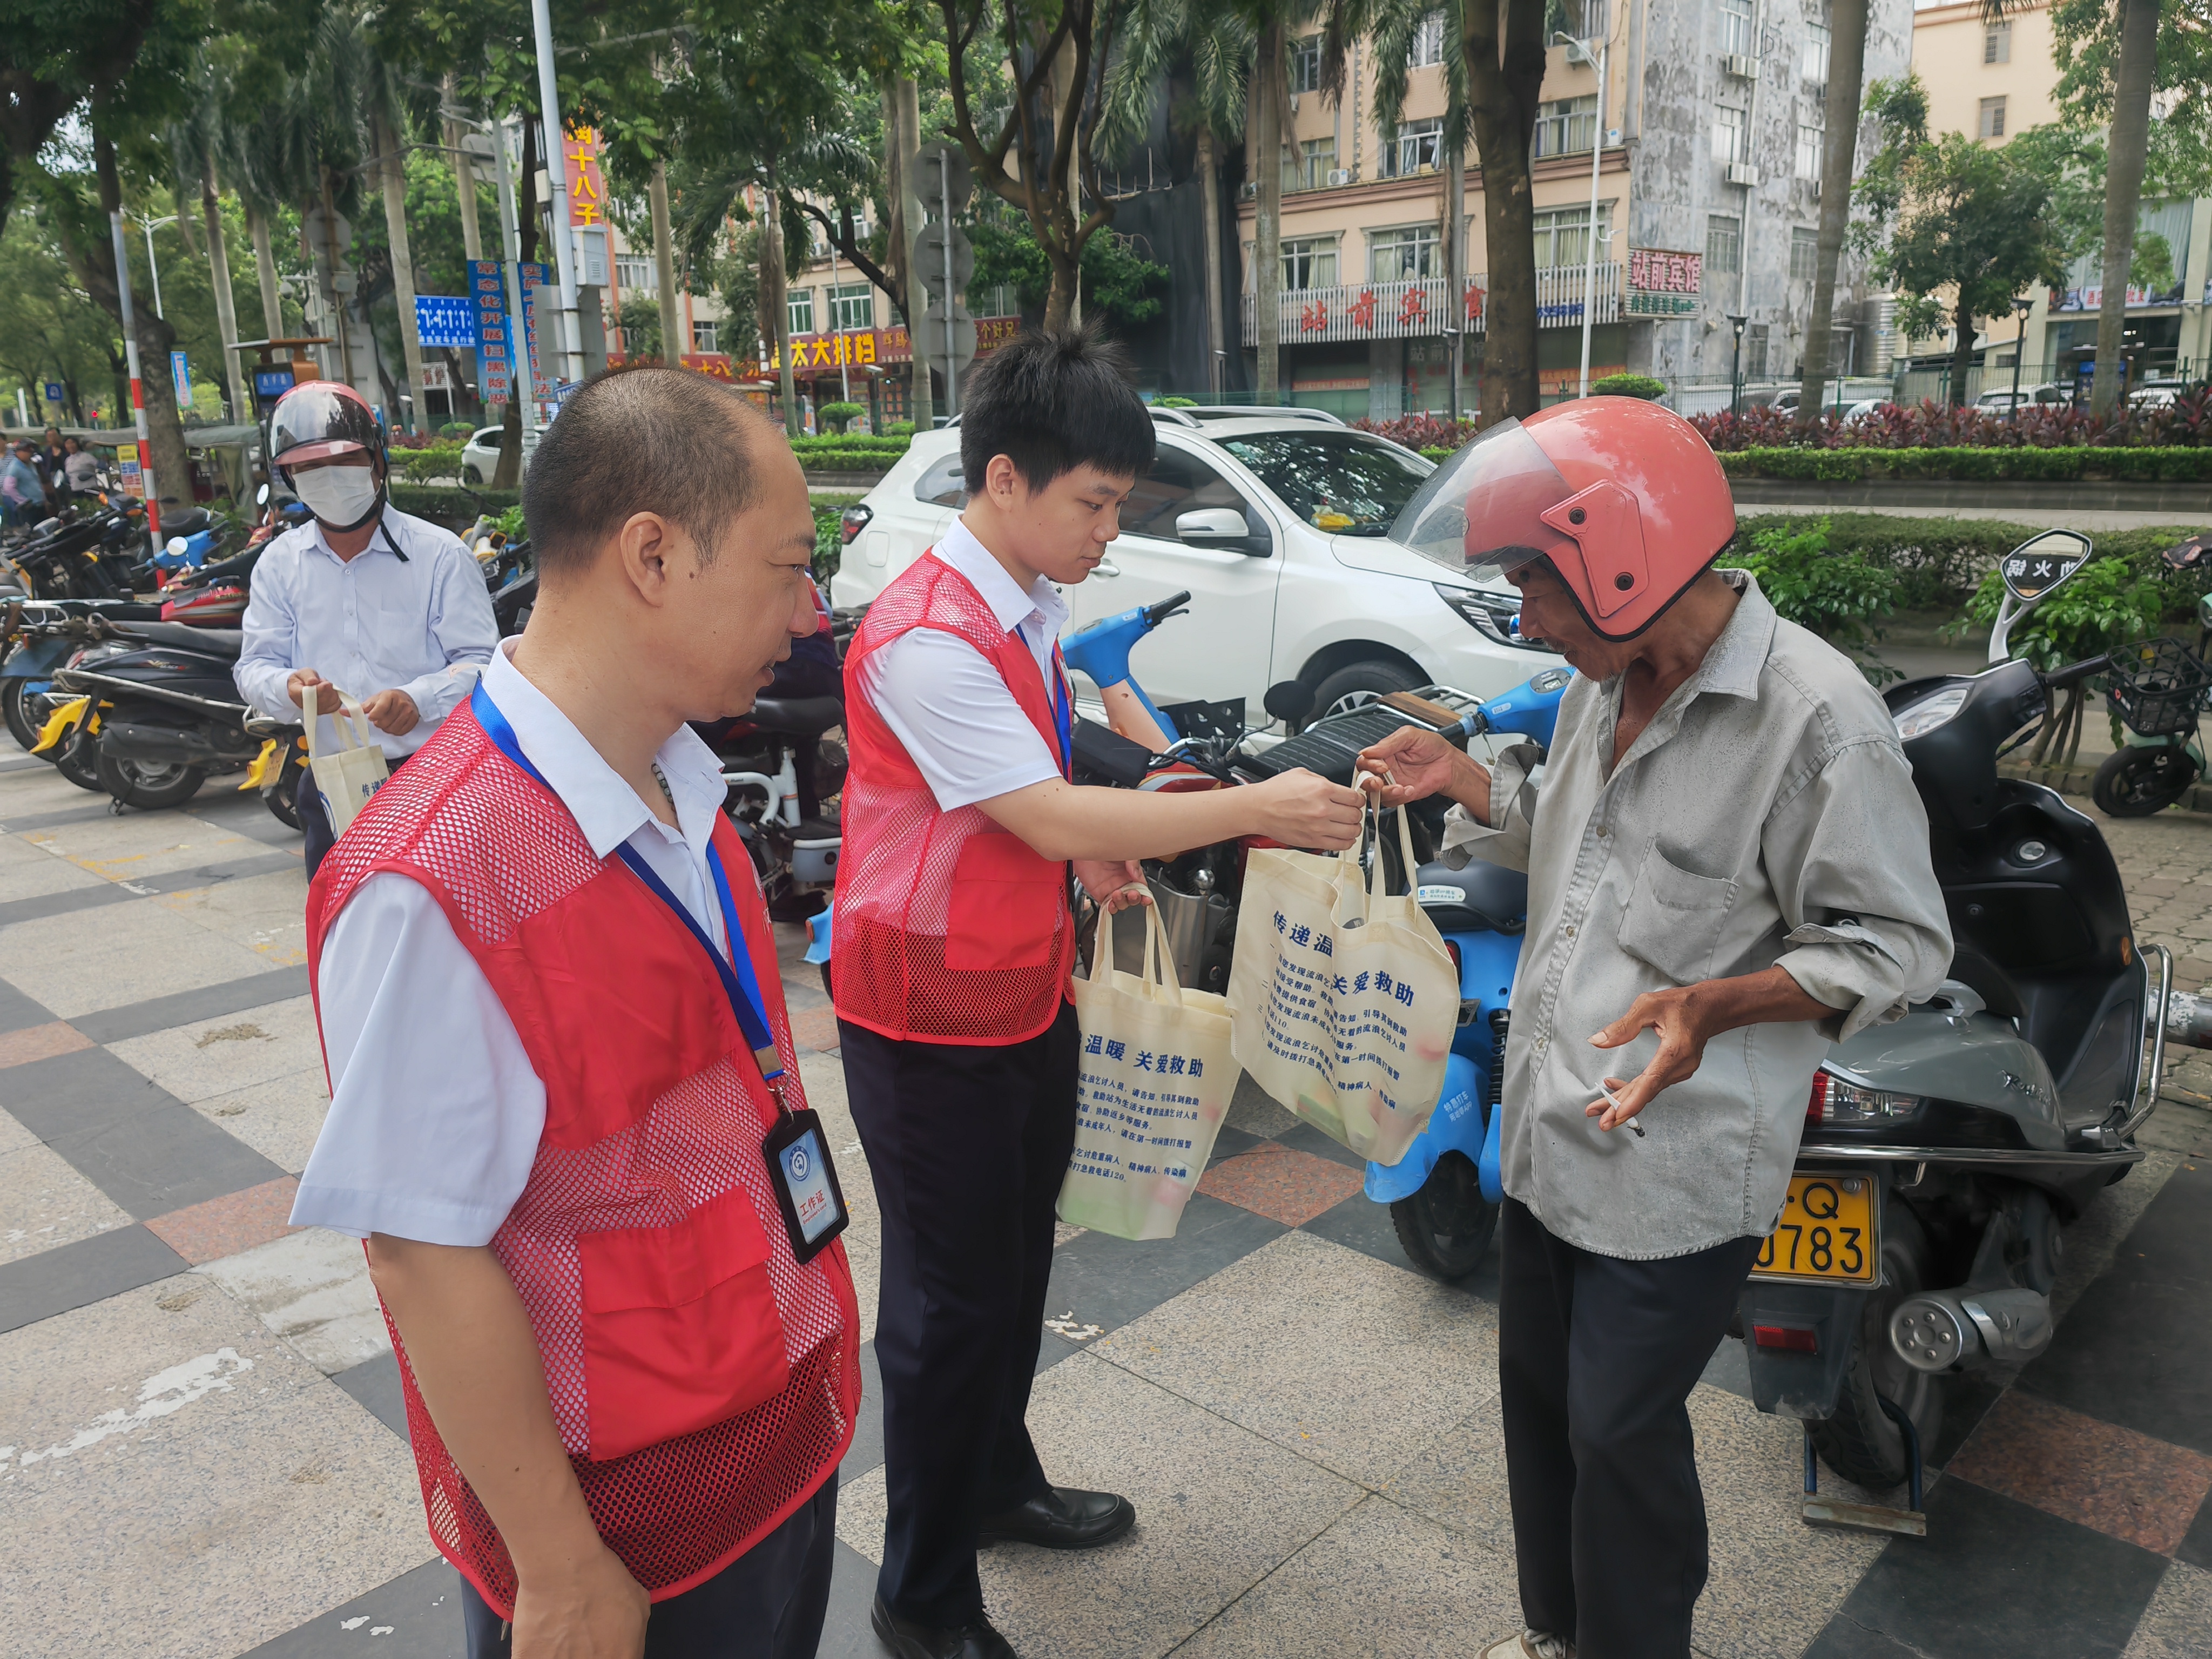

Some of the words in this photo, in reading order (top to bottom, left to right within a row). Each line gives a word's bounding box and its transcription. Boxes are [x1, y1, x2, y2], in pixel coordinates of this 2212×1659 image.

[1631, 251, 1701, 293] 站前宾馆
[1333, 970, 1414, 1007] 关爱救助
[1079, 1030, 1126, 1062] 温暖
[1133, 1050, 1203, 1077] 关爱救助
[799, 1189, 826, 1217] 工作证
